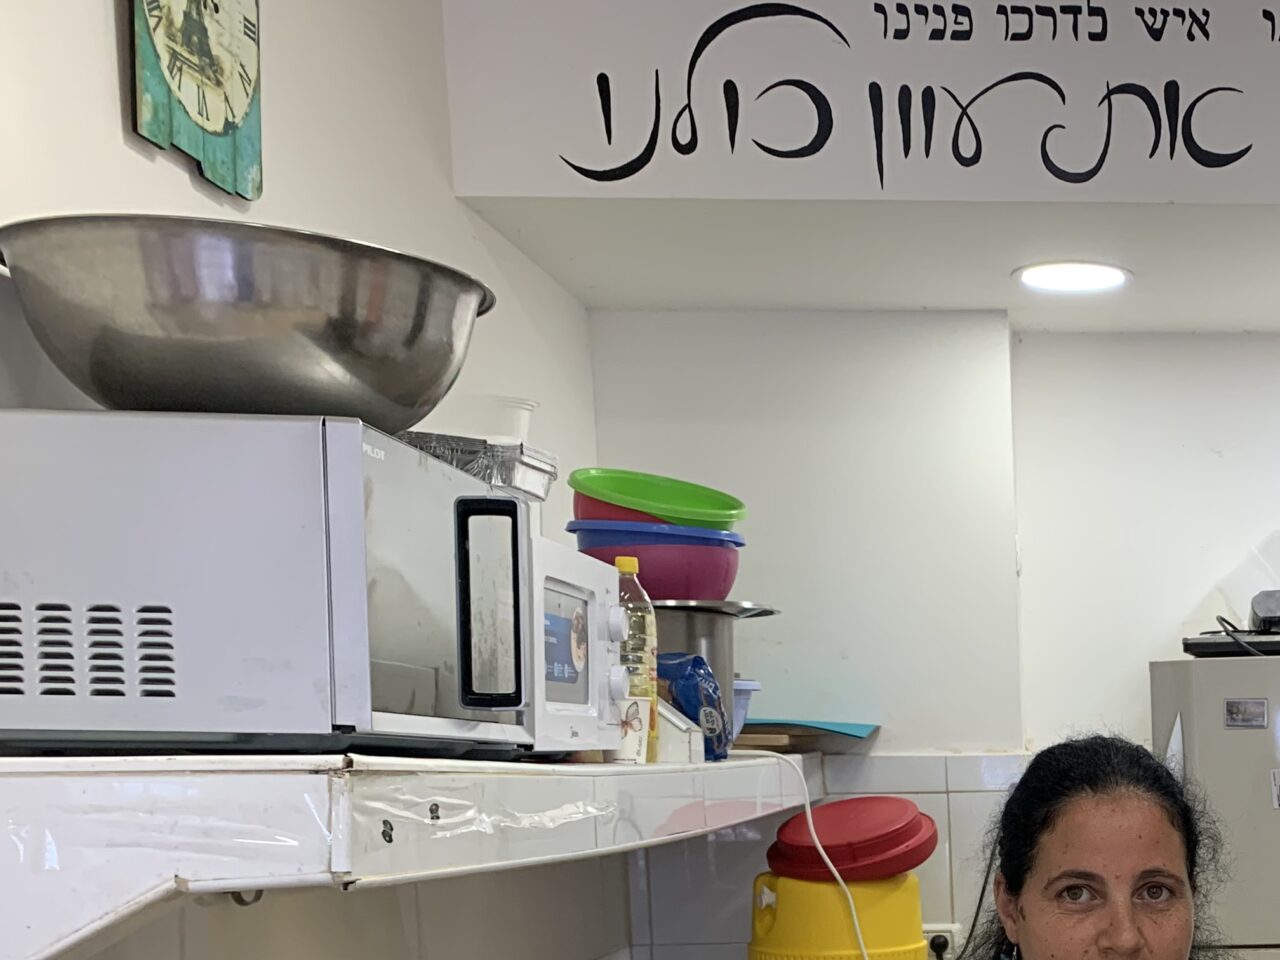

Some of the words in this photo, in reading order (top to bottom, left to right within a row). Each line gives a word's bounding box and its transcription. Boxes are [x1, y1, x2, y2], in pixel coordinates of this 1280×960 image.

[874, 2, 974, 41] פנינו
[1135, 7, 1210, 42] איש
[559, 2, 856, 182] כולנו
[868, 71, 1066, 190] עוון
[1040, 79, 1254, 184] את
